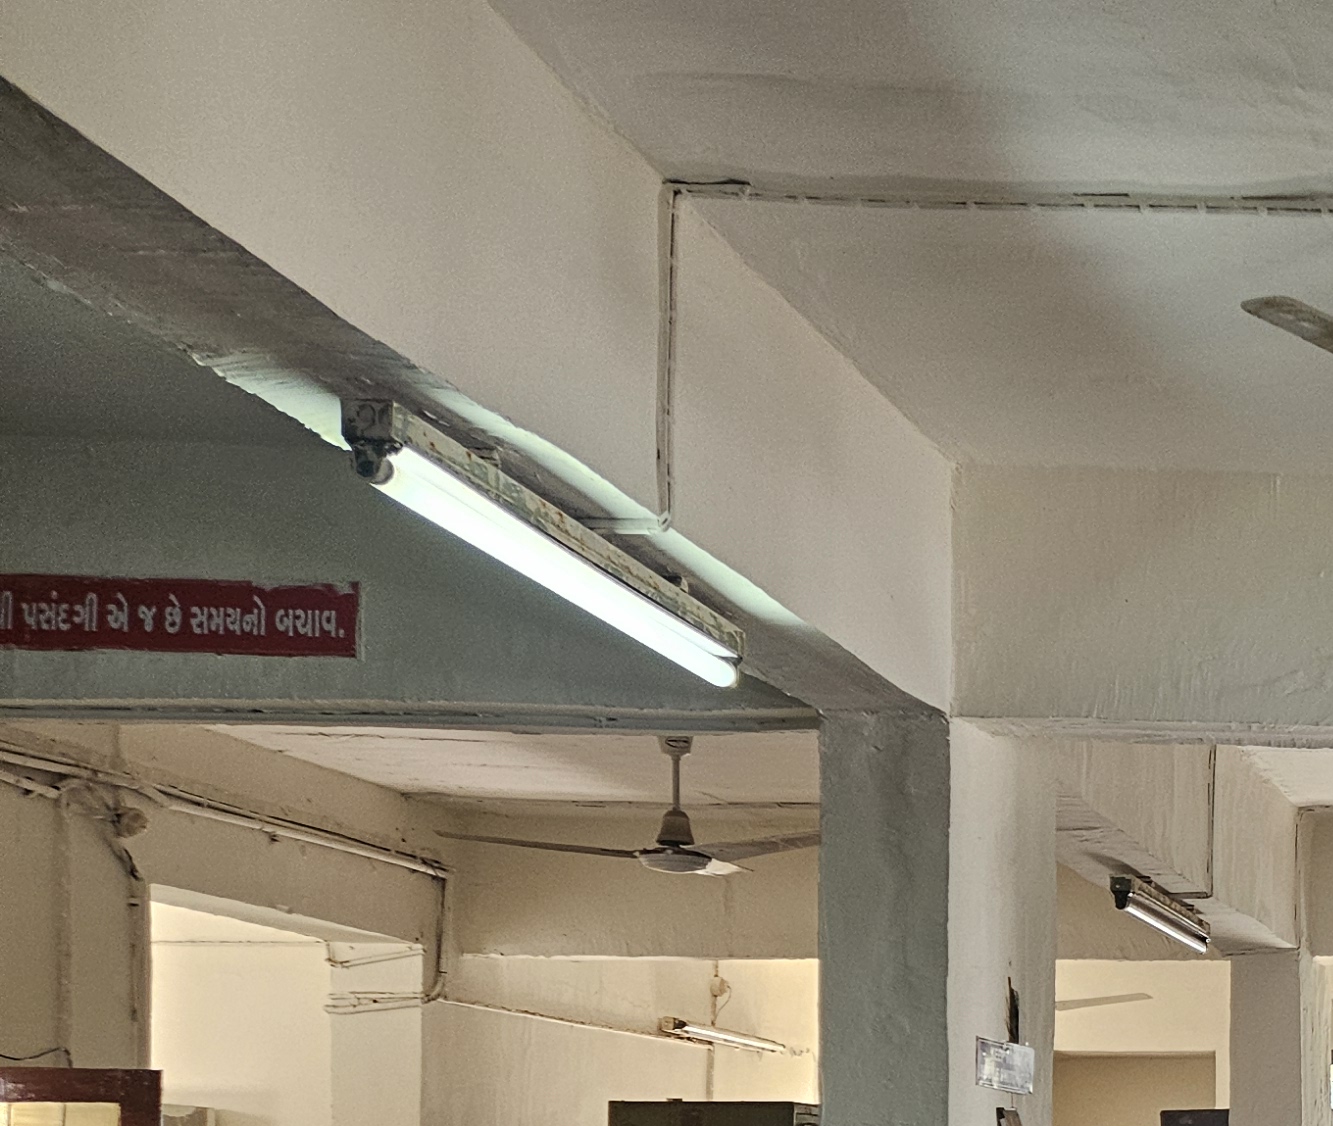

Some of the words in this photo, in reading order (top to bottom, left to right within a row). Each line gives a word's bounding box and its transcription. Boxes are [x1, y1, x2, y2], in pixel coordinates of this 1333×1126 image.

[21, 590, 98, 632] પસંદગી
[106, 592, 129, 632] એ
[137, 606, 158, 632] જ
[164, 593, 182, 634] છે
[190, 595, 266, 636] સમયનો
[275, 607, 346, 639] બચાવ.
